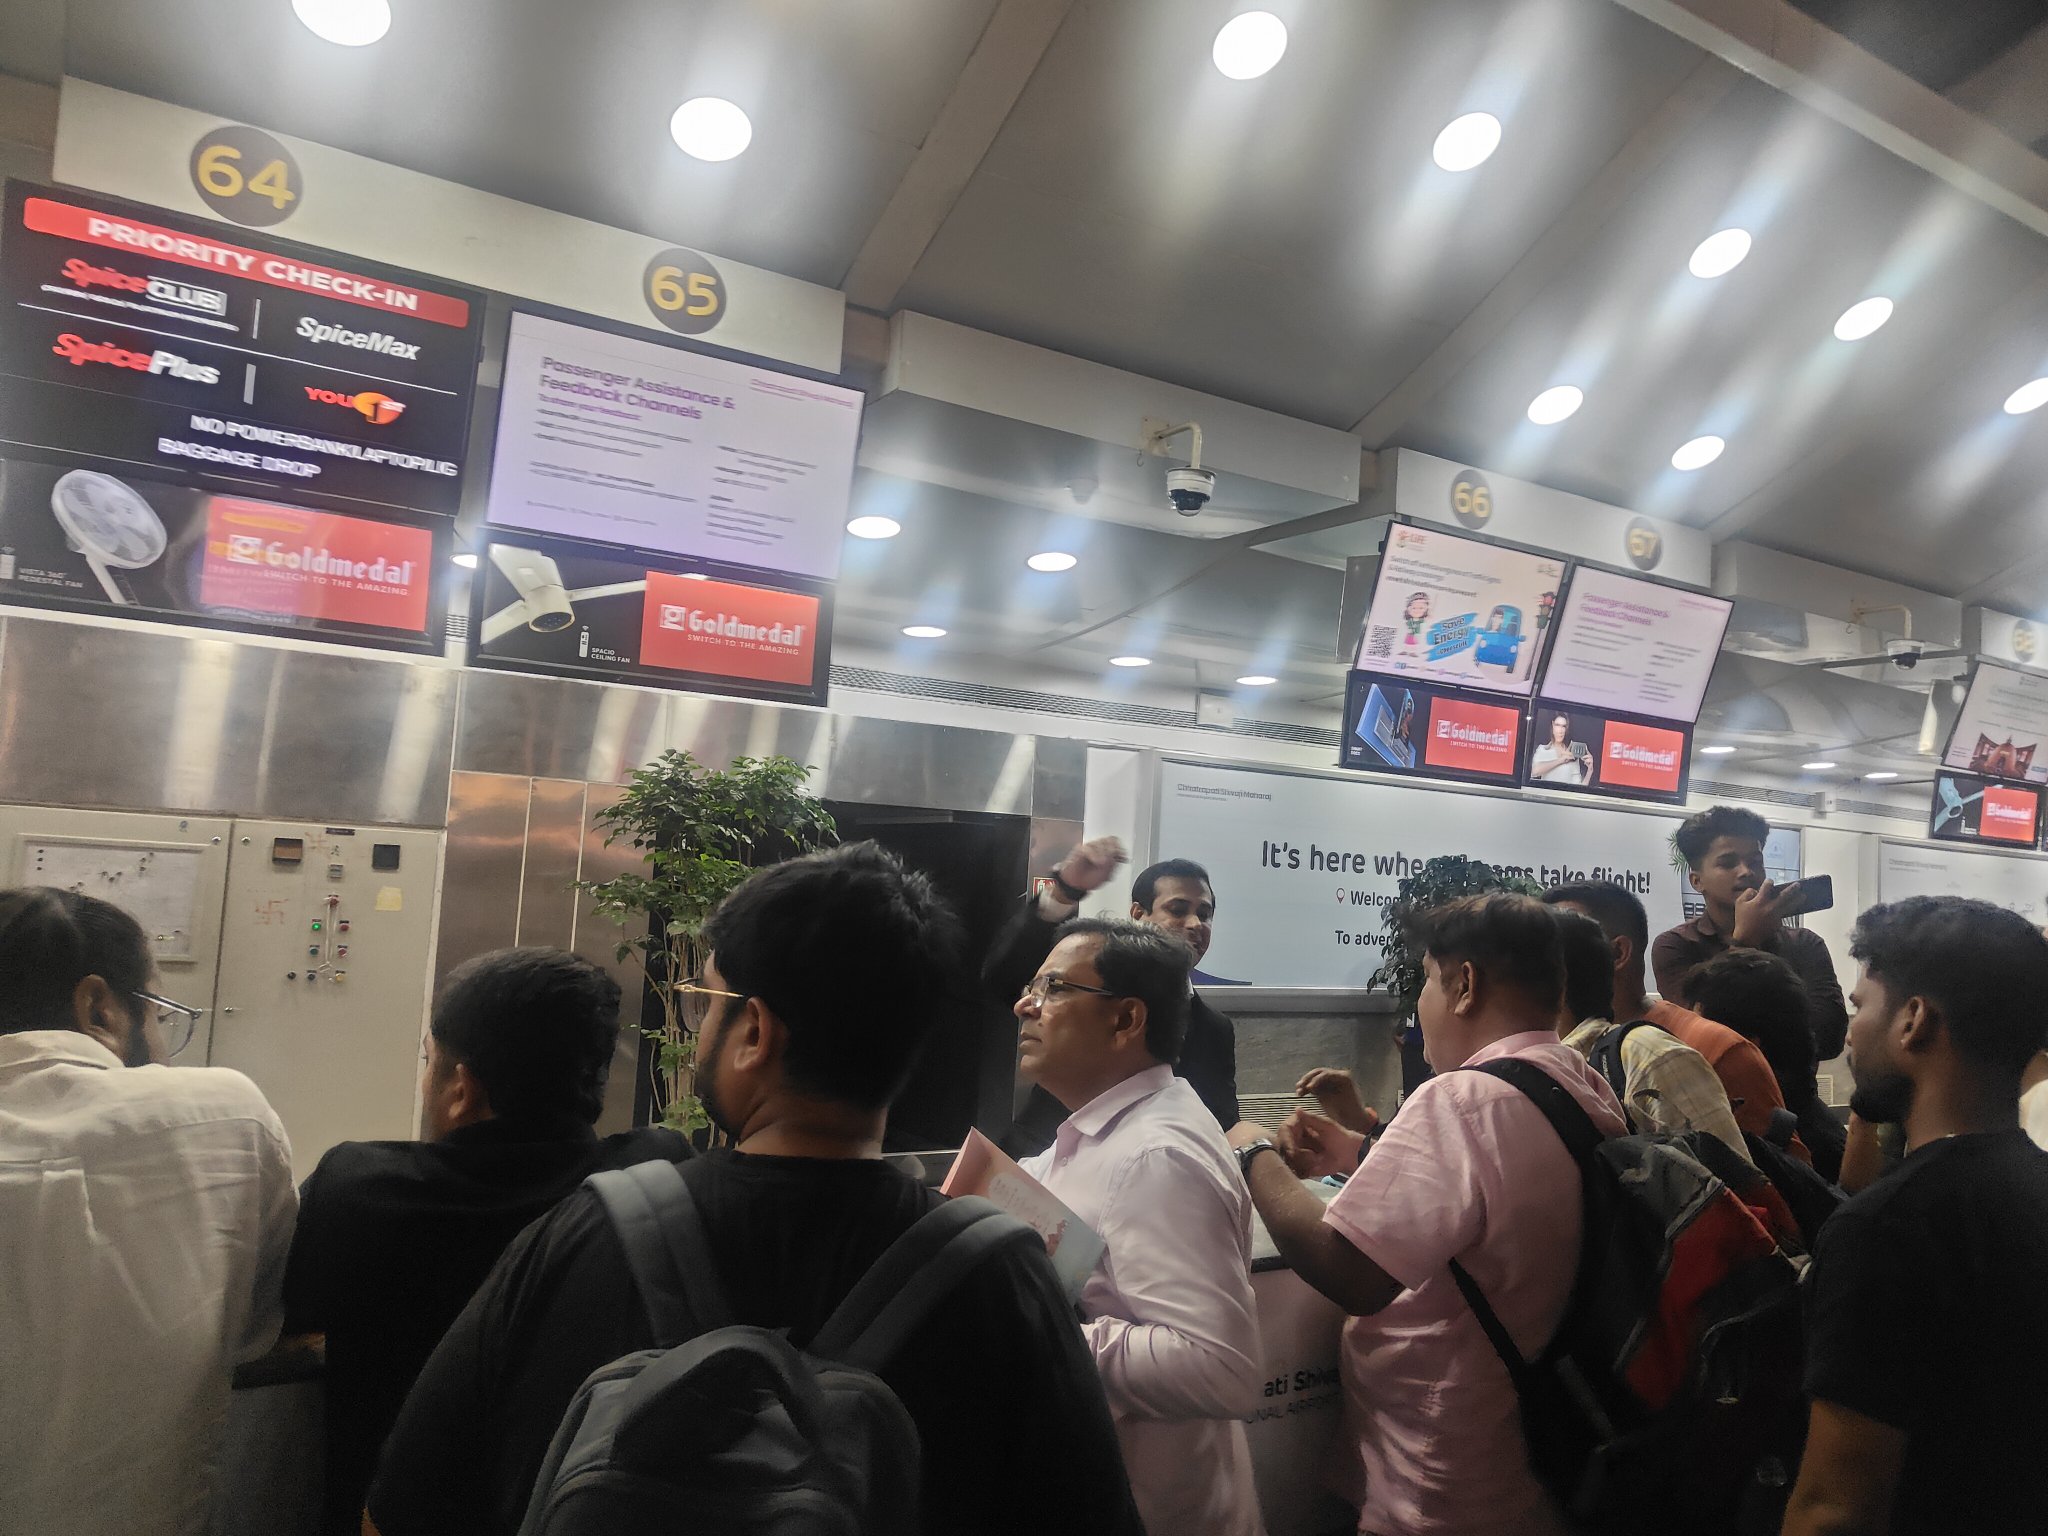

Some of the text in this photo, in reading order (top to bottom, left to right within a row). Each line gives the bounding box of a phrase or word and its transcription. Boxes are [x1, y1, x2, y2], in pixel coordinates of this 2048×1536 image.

[197, 144, 295, 209] 64
[88, 217, 256, 272] PRIORITY
[262, 259, 418, 311] CHECK-IN
[651, 266, 718, 317] 65
[296, 316, 422, 361] SpiceMax
[539, 373, 624, 403] Feedback
[626, 392, 703, 420] Channels
[541, 355, 632, 387] Passenger
[634, 376, 721, 406] Assistance
[1454, 482, 1490, 518] 66
[264, 541, 411, 586] Goldmedal
[263, 569, 408, 596] SWITCH TO THE AMAZING
[687, 633, 799, 656] SWITCH TO THE AMAZING
[688, 609, 803, 647] Goldmedal
[591, 652, 631, 664] CEILING FAN
[1450, 722, 1509, 746] Goldmedal
[1622, 744, 1675, 765] Goldmedal
[1262, 840, 1300, 869] It's
[1310, 844, 1366, 874] here
[1374, 851, 1425, 877] whe
[1335, 930, 1350, 945] To
